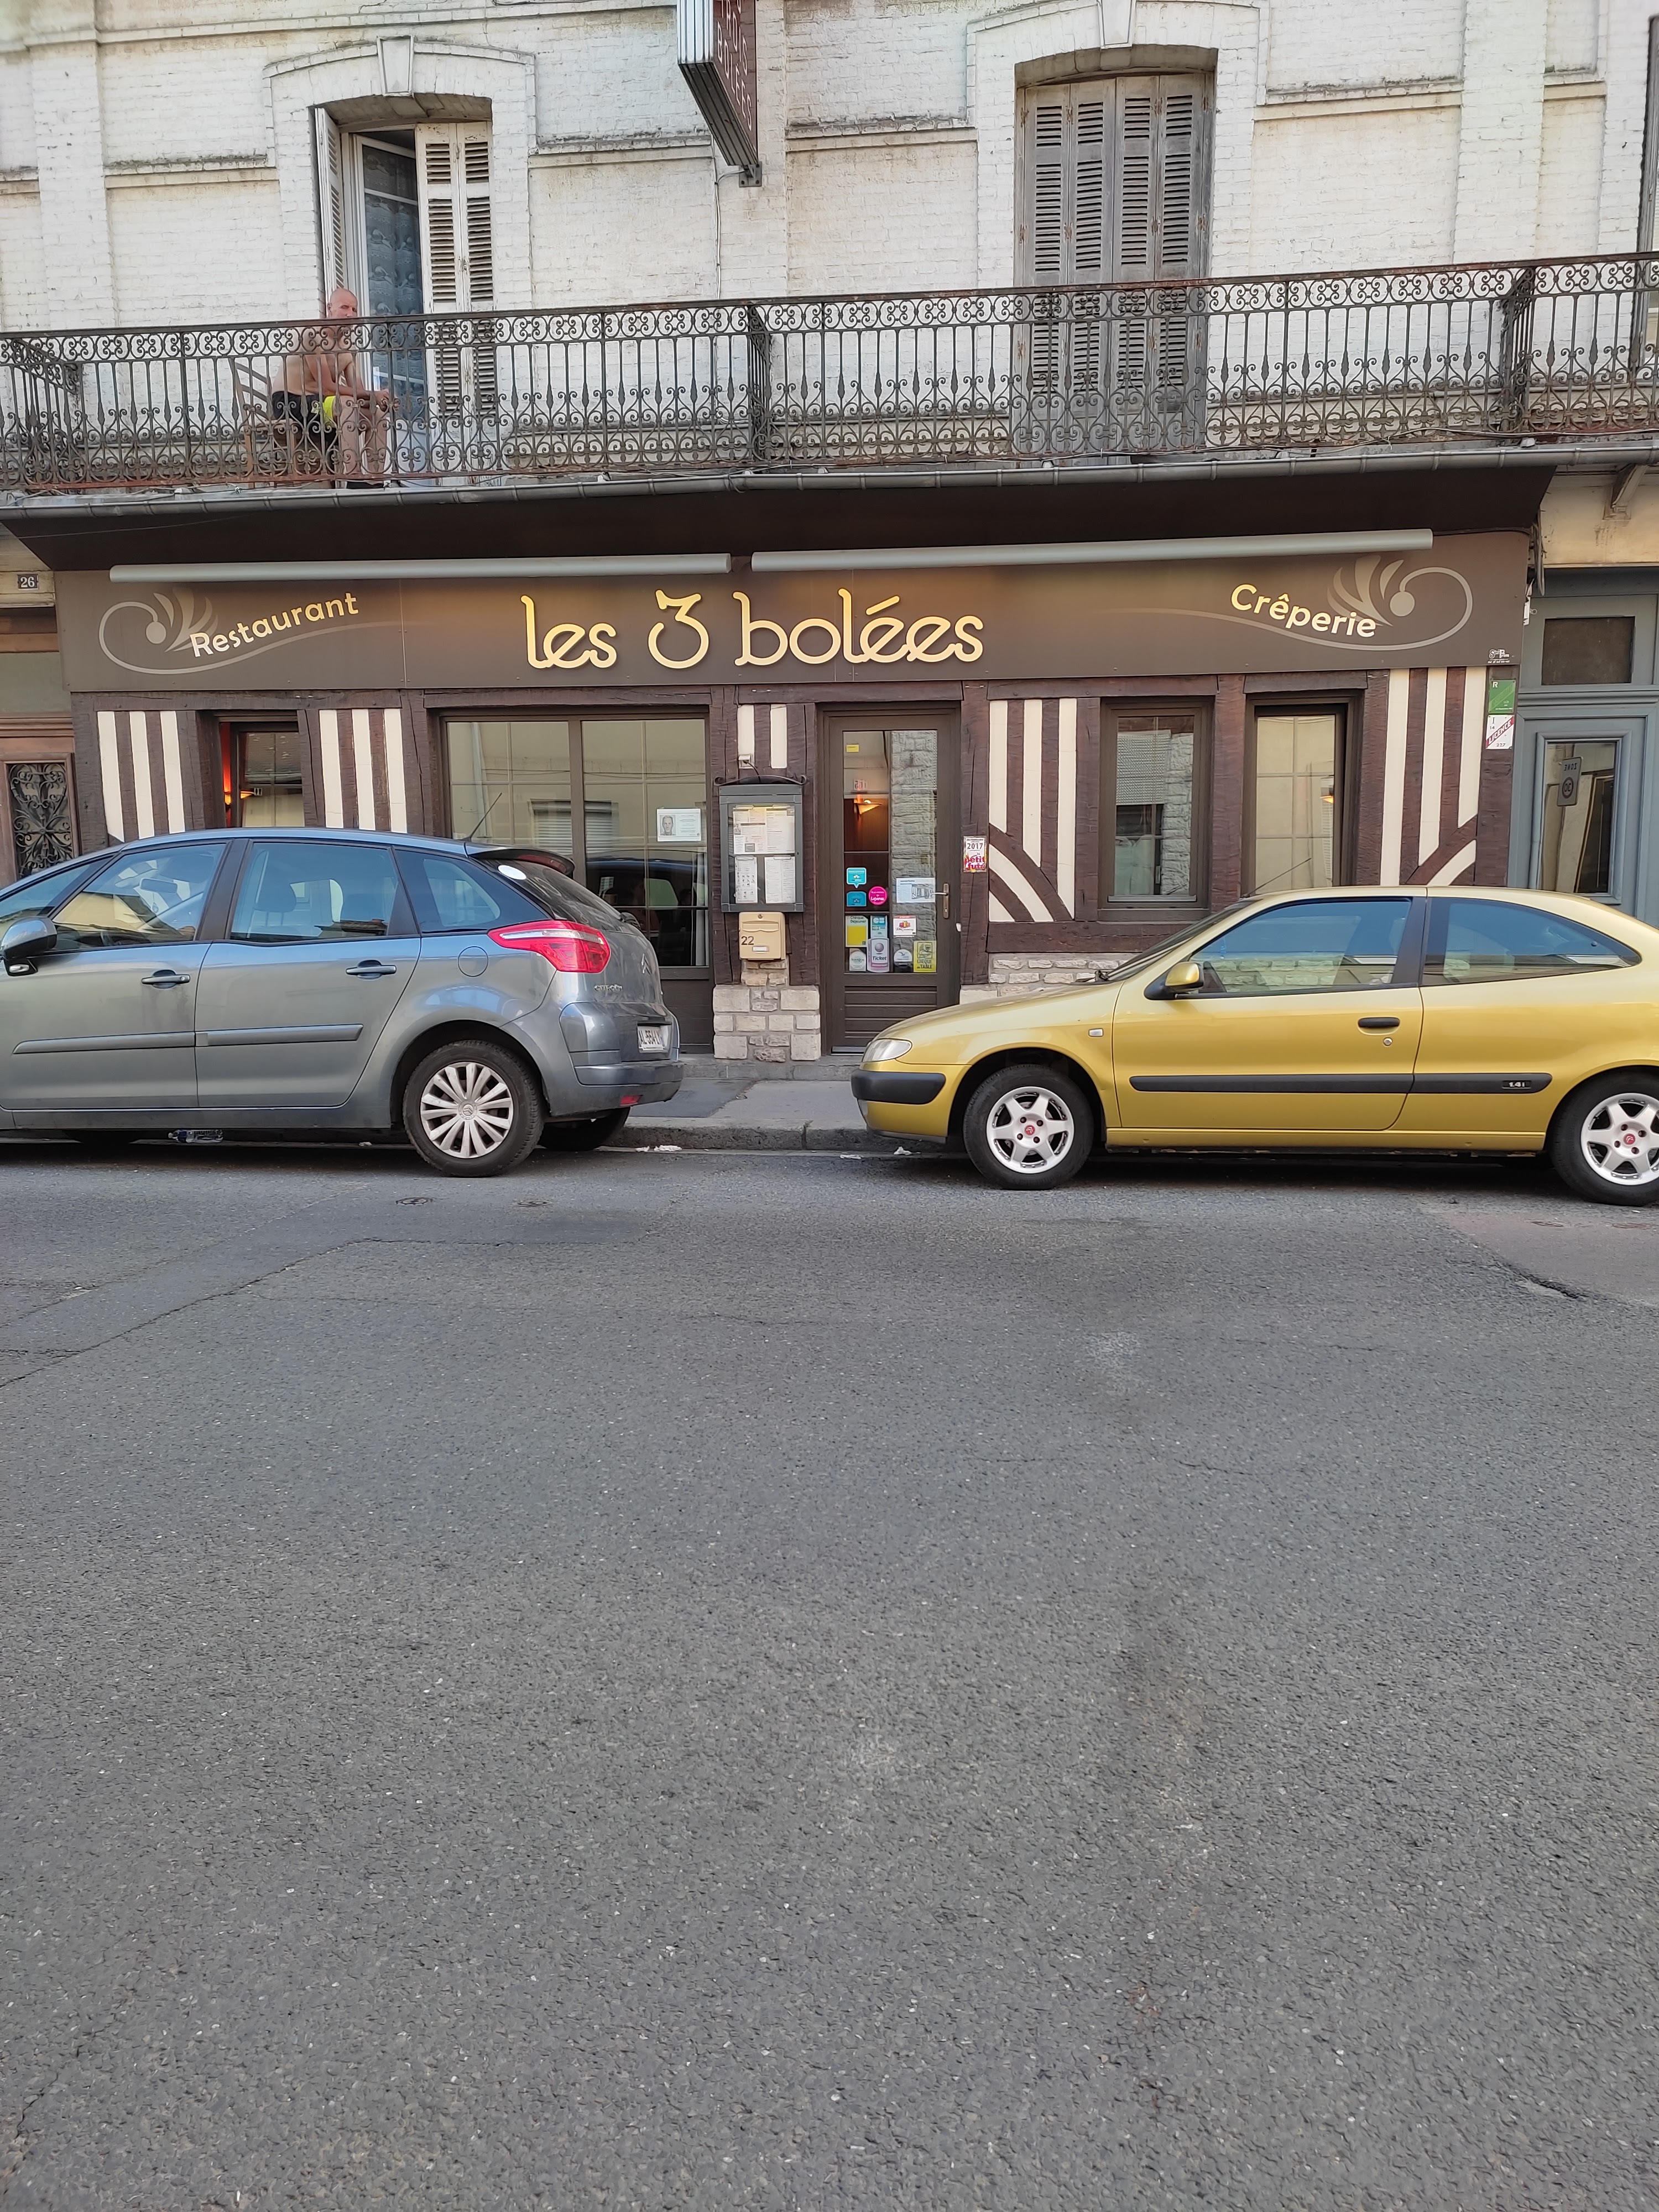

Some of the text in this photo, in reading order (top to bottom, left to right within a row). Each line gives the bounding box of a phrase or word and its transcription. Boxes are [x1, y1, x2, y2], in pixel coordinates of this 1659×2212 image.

[20, 576, 35, 588] 26
[190, 592, 359, 658] Restaurant
[520, 588, 984, 669] les 3 bolées
[1230, 583, 1376, 638] Crêperie
[1488, 719, 1512, 745] LICENCE
[740, 936, 754, 946] 22
